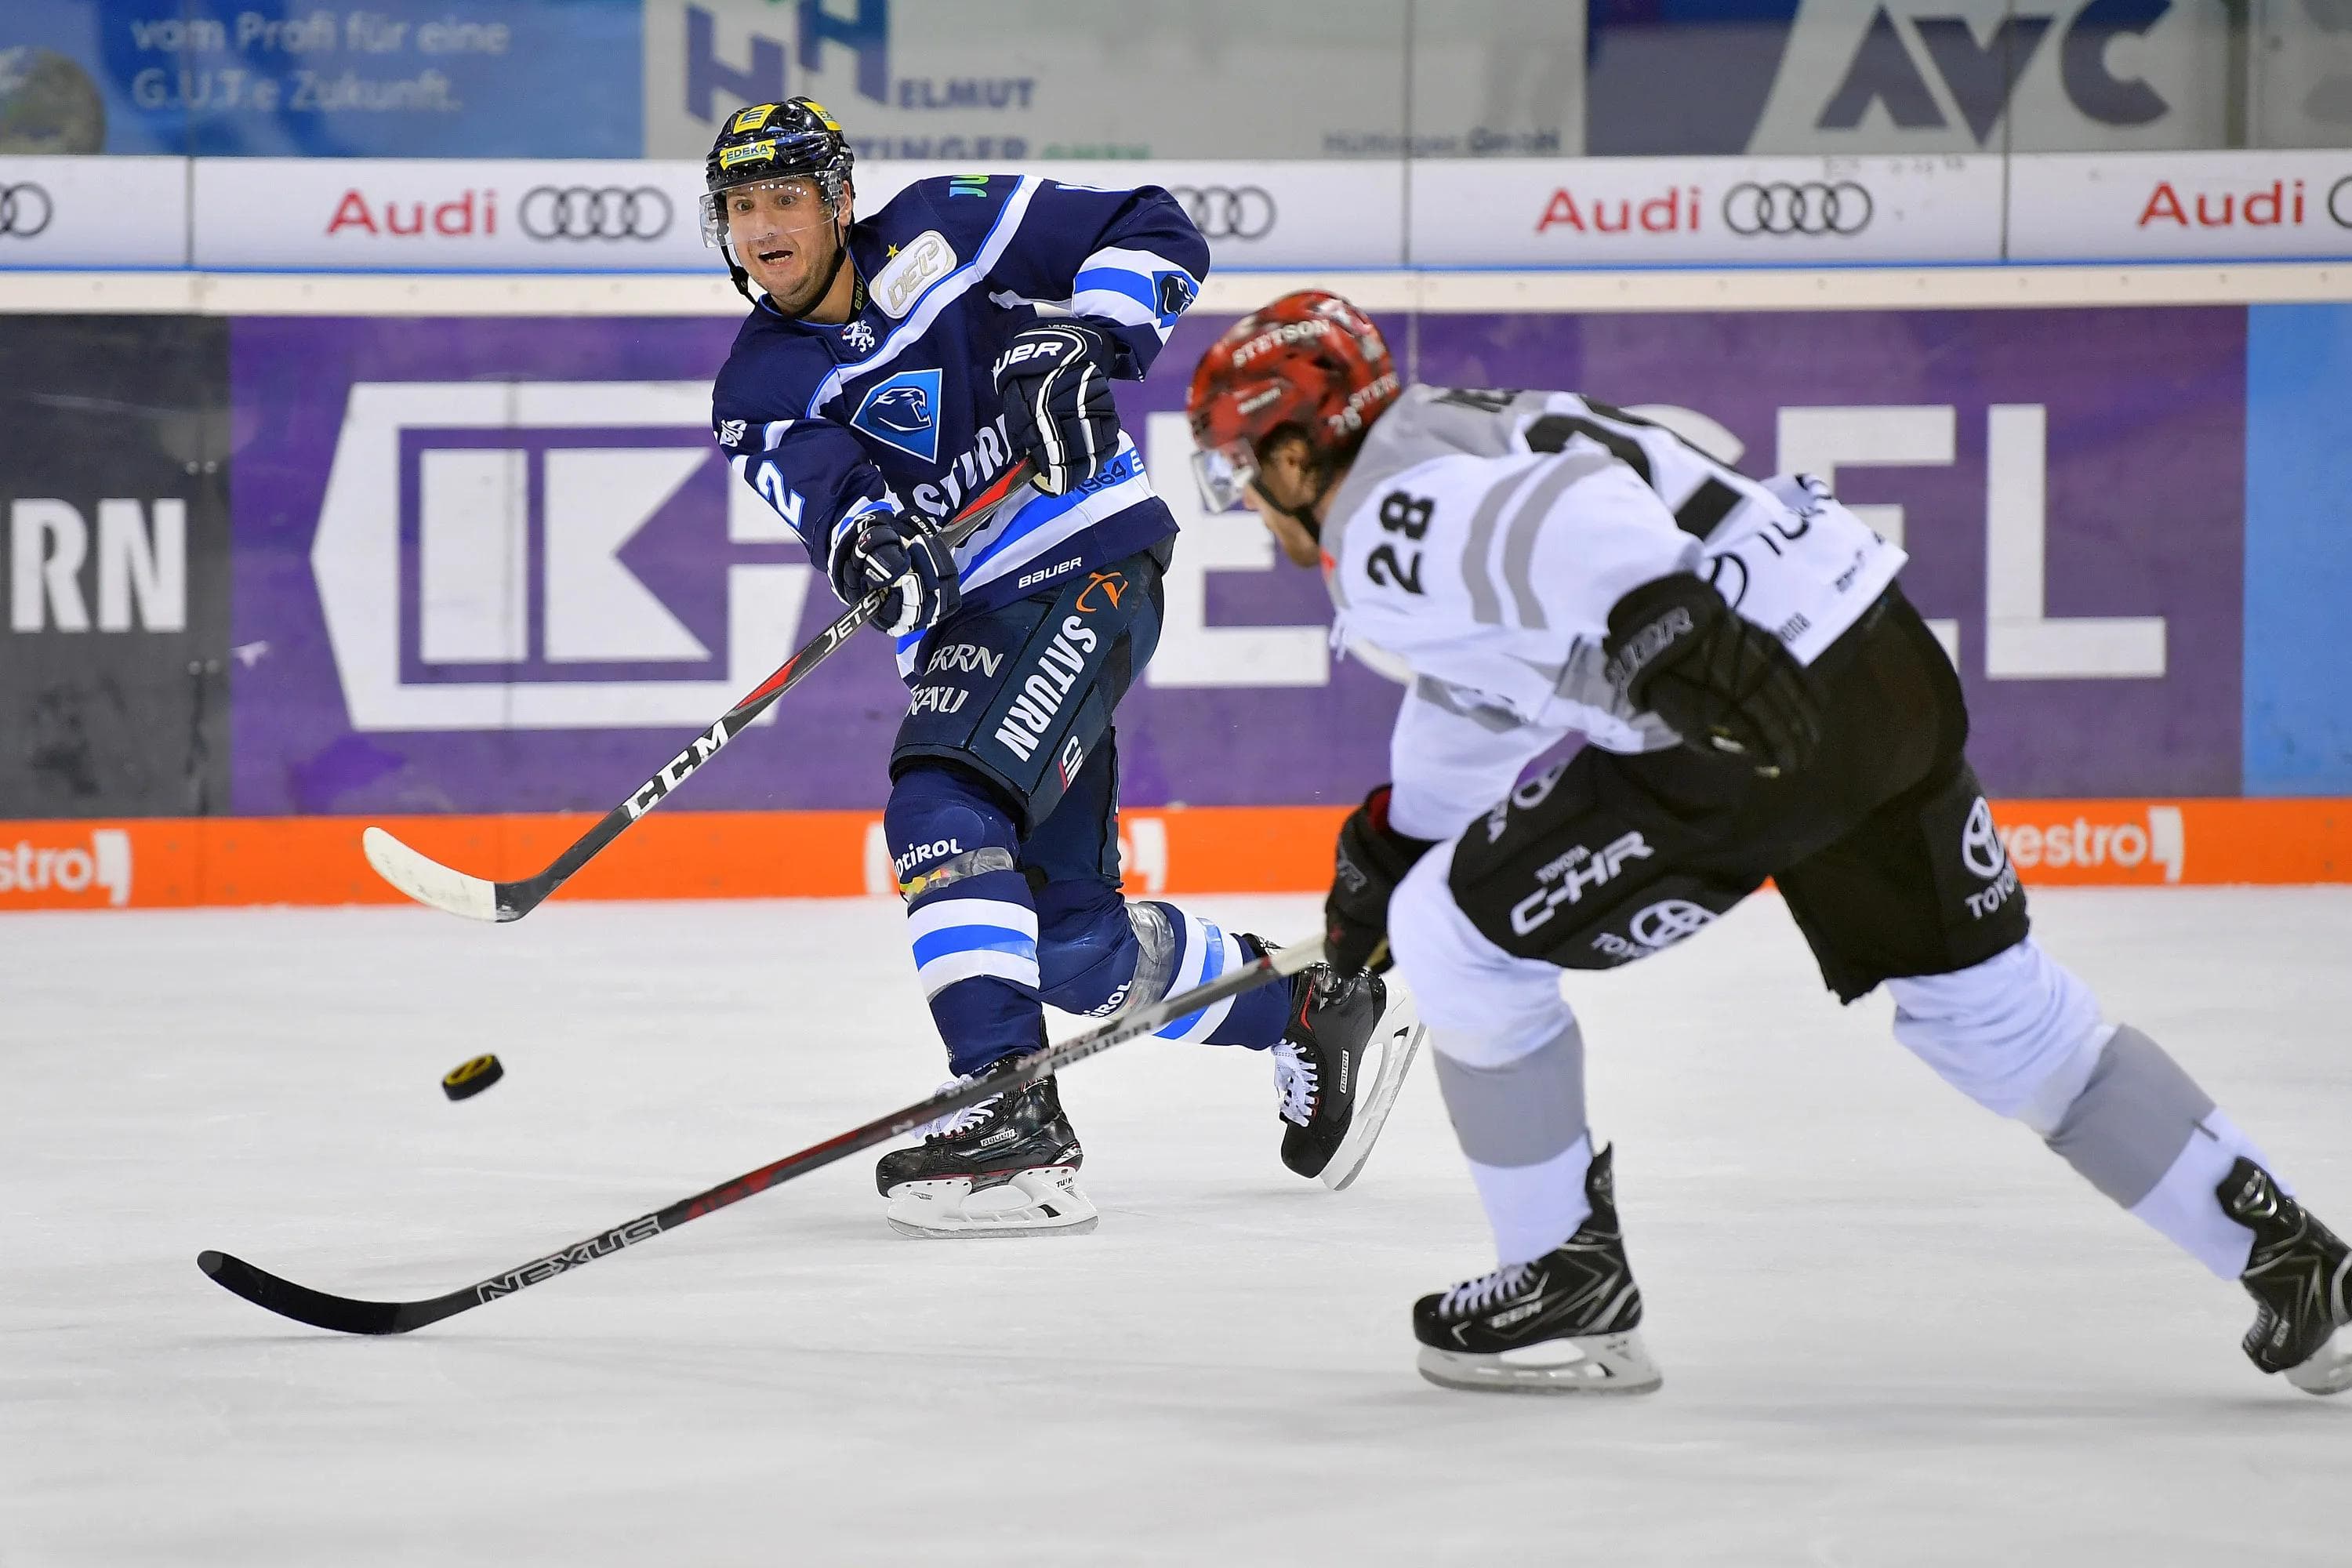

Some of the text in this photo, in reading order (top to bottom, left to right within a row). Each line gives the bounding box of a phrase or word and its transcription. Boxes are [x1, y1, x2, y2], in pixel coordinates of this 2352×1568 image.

[129, 10, 511, 54] vom Profi für eine
[1814, 0, 2172, 147] AVC
[725, 143, 770, 162] EDEKA
[325, 189, 498, 235] Audi
[1534, 187, 1703, 234] Audi
[2138, 180, 2305, 228] Audi
[10, 496, 187, 633] RN
[1018, 556, 1082, 590] BAUER
[1367, 490, 1435, 596] 28
[994, 615, 1098, 763] SATURN
[622, 720, 730, 820] CCM
[1510, 829, 1656, 937] C-HR
[1340, 1051, 1349, 1093] BAUER
[476, 1215, 664, 1305] NEXUS
